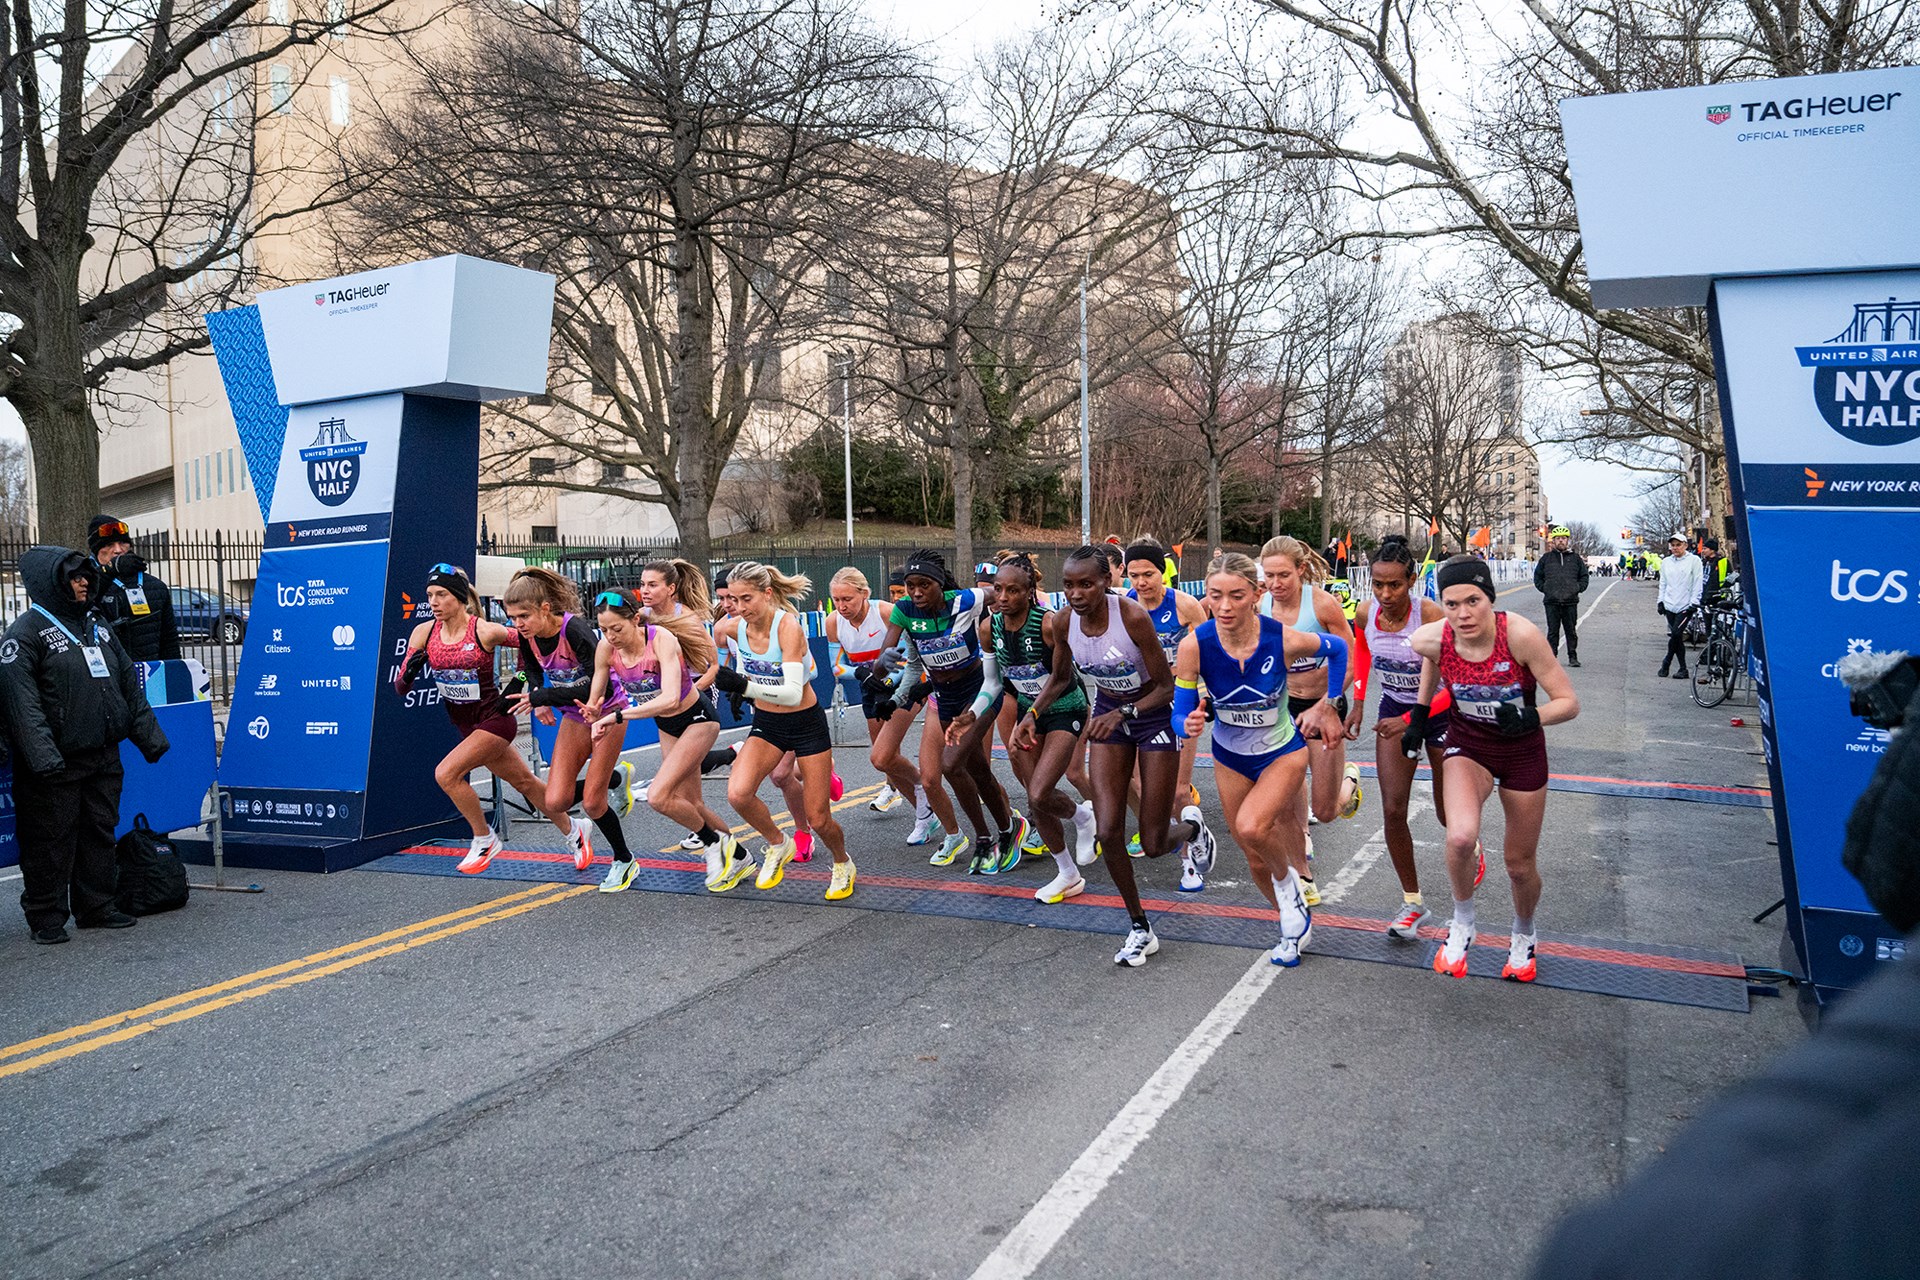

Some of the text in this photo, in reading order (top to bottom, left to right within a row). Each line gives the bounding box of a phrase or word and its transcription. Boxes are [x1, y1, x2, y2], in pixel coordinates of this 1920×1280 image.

[1708, 106, 1729, 114] TAG
[1737, 123, 1865, 142] OFFICIAL TIMEKEEPER
[1810, 351, 1869, 361] UNITED
[304, 445, 362, 458] UNITED AIRLINES
[314, 459, 353, 482] NYC
[318, 481, 350, 497] HALF
[1829, 480, 1865, 492] NEW
[1866, 480, 1907, 492] YORK
[298, 524, 368, 538] NEW YORK ROAD RUNNERS
[307, 579, 325, 588] TATA
[1831, 559, 1908, 604] tcs
[277, 582, 305, 607] tcs
[307, 587, 350, 597] CONSULTANCY
[307, 597, 335, 606] SERVICES
[264, 644, 291, 654] Citizens
[932, 651, 960, 665] LOKEDI
[301, 679, 339, 688] UNITED
[445, 686, 469, 698] SISSON
[1475, 704, 1494, 716] KEI
[1231, 713, 1265, 725] VAN ES
[306, 721, 339, 735] ESPN
[1846, 743, 1869, 752] new
